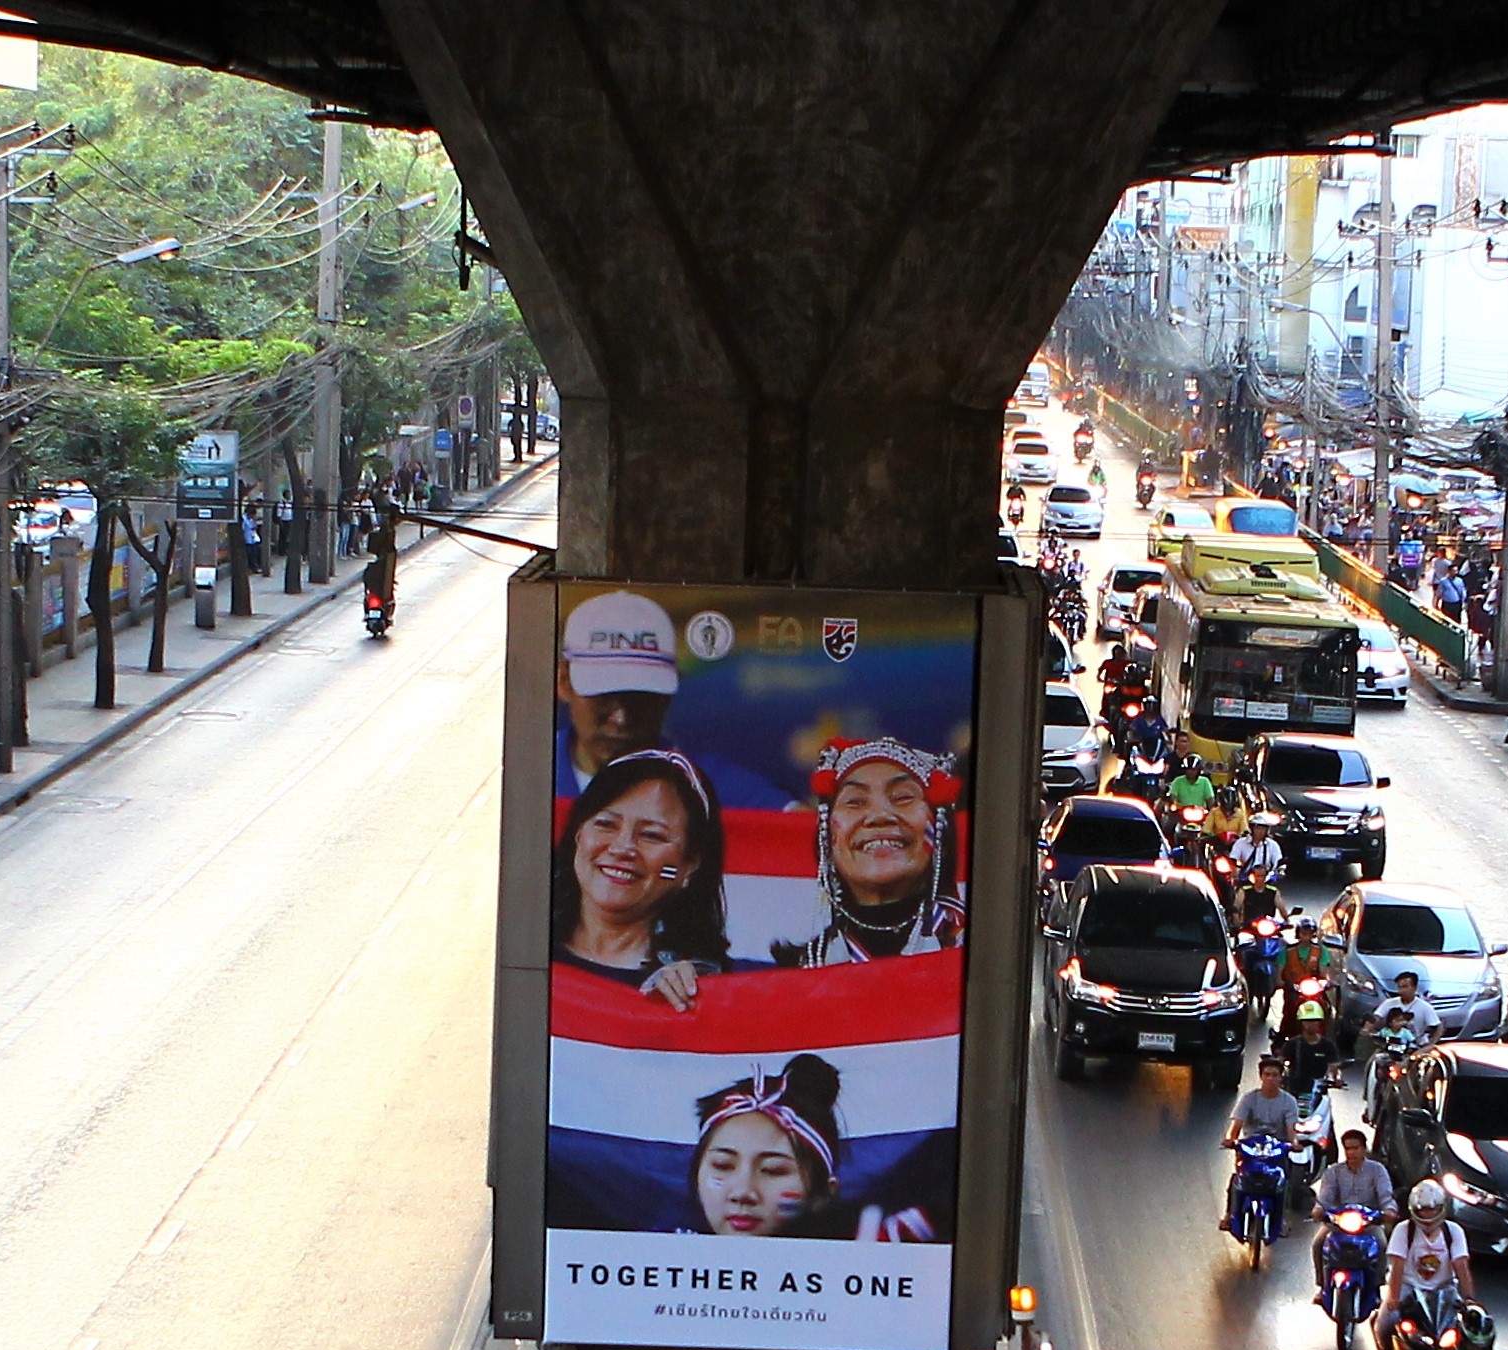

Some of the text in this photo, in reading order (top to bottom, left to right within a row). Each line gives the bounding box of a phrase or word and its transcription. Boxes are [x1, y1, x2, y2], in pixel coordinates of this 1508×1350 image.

[589, 631, 660, 651] PING
[566, 1262, 915, 1298] TOGETHER AS ONE
